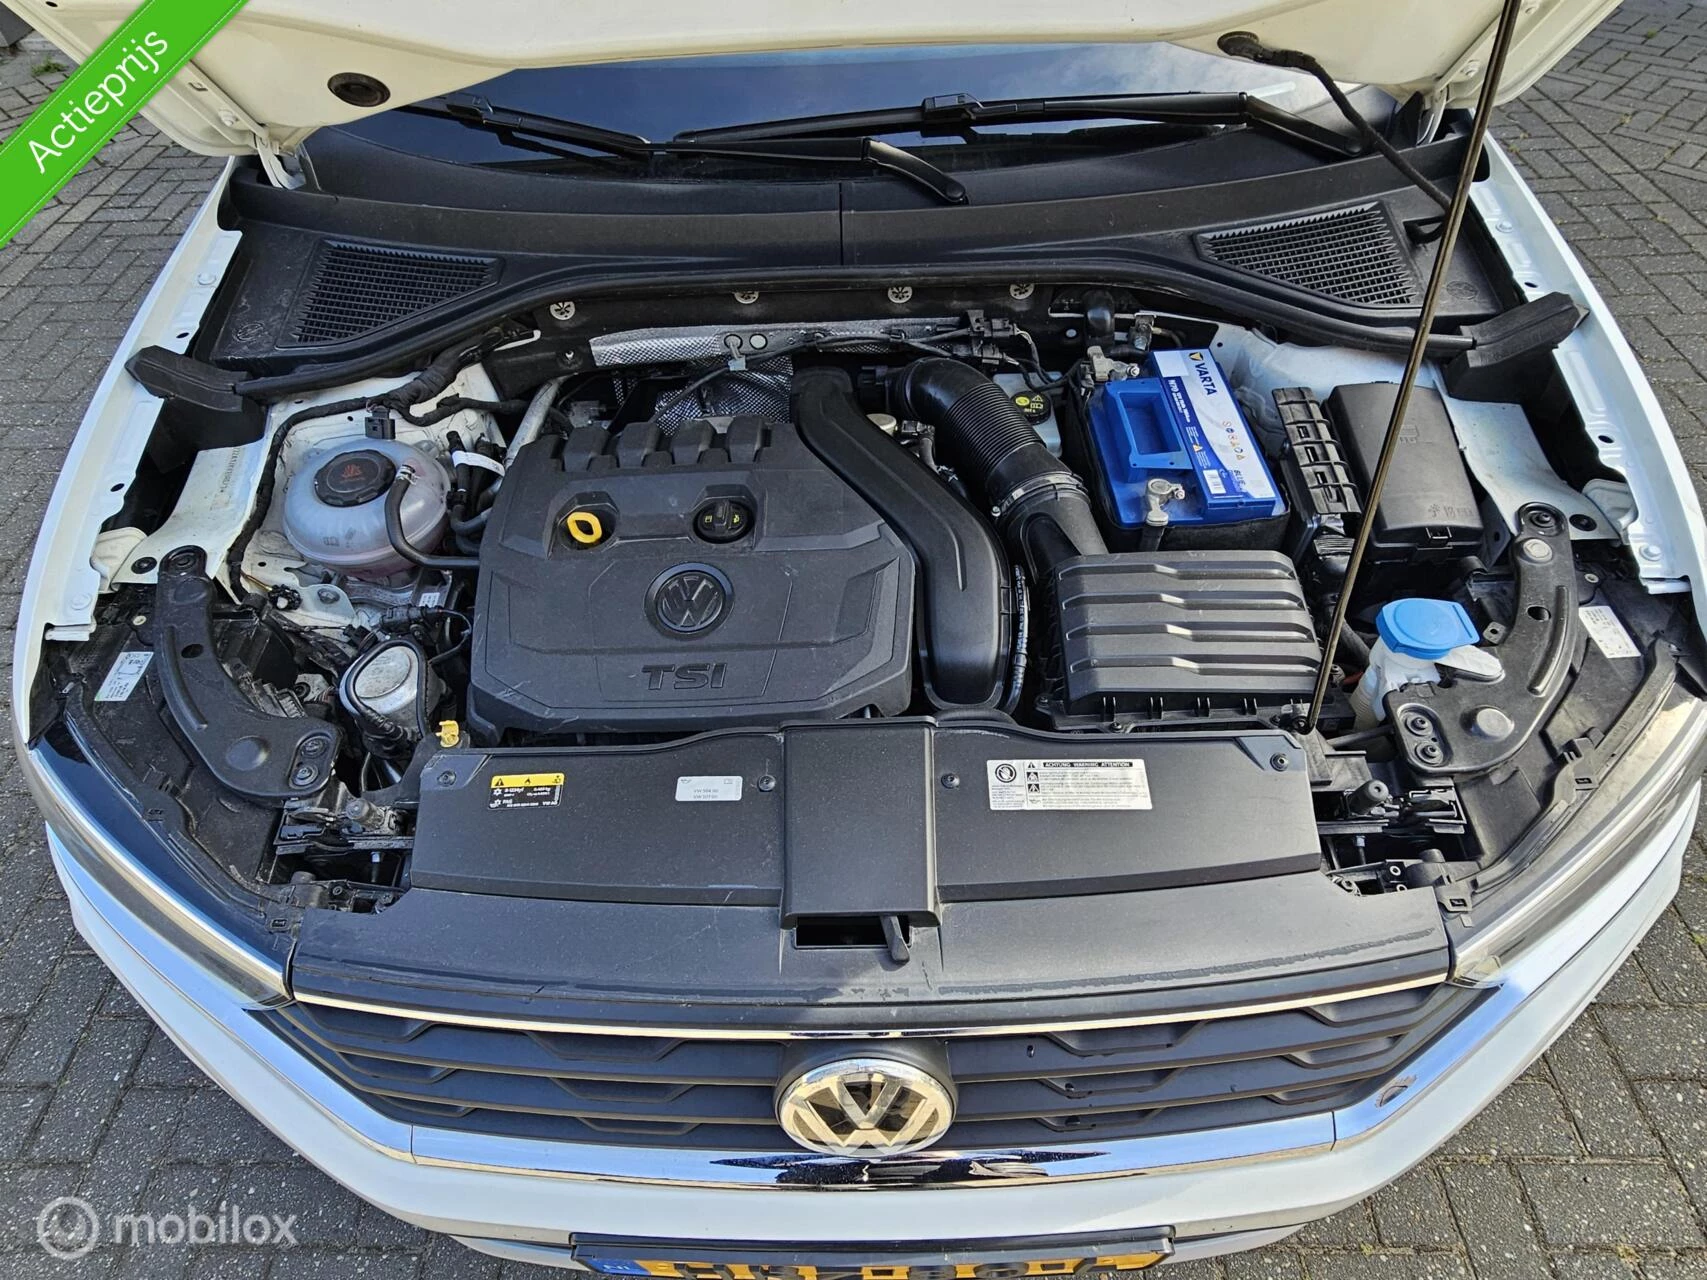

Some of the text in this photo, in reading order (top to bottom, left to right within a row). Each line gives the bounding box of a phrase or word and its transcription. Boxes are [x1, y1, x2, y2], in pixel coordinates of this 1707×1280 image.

[1195, 363, 1218, 396] VARTA
[641, 662, 727, 691] TSI
[779, 1059, 952, 1157] VW
